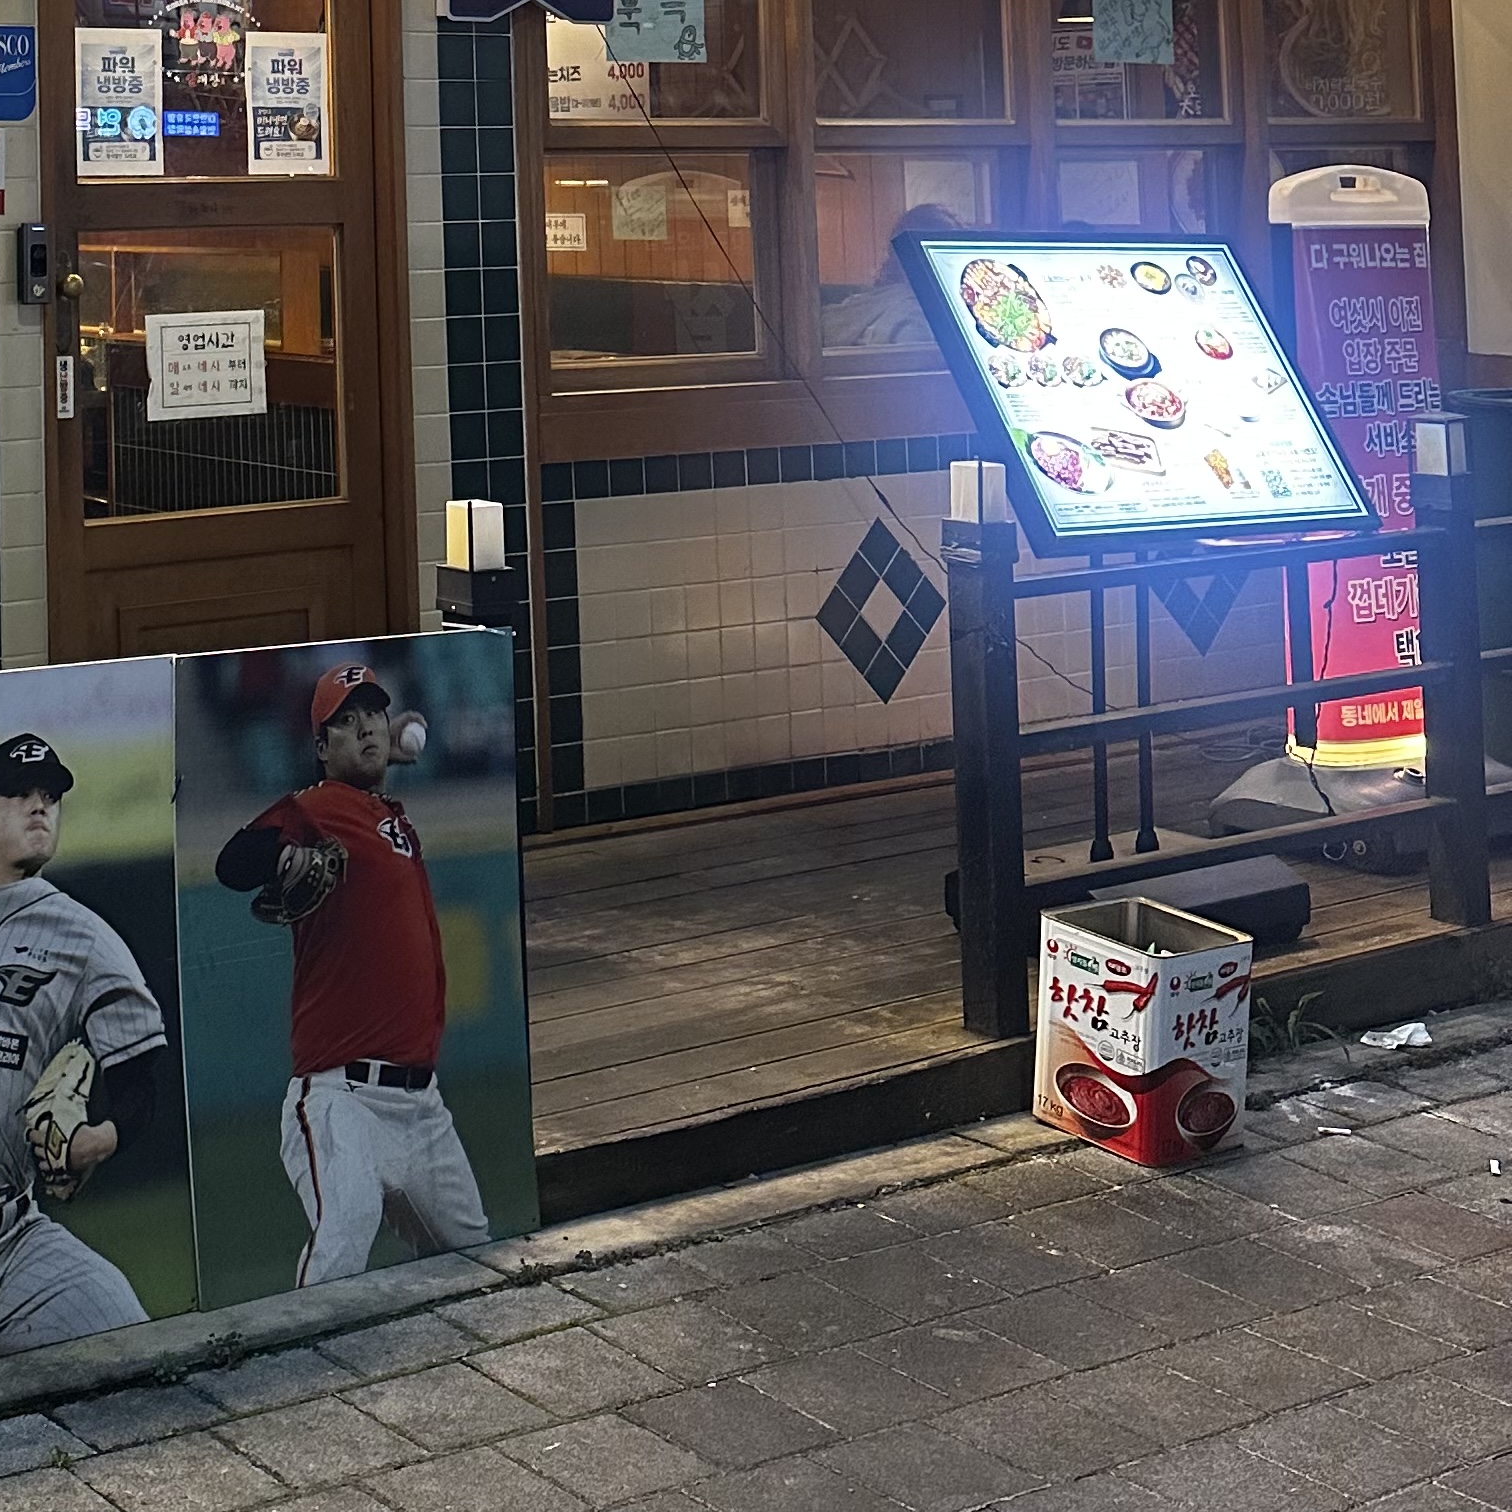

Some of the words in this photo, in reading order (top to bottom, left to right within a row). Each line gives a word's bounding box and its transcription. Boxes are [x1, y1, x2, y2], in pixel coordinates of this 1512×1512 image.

[270, 58, 303, 76] 파워
[607, 62, 644, 81] 4,000
[96, 75, 144, 94] 냉방중
[265, 76, 310, 95] 냉방중
[1310, 244, 1329, 269] 다
[1332, 243, 1411, 270] 구워나오는
[1413, 242, 1428, 269] 집
[1329, 295, 1387, 334] 여섯시
[1388, 295, 1424, 332] 이전
[178, 331, 235, 351] 영업시간
[1343, 337, 1381, 376] 입장
[1384, 337, 1419, 374] 주문
[1316, 379, 1395, 419] 손님들께
[1396, 377, 1442, 413] 드리는
[1347, 573, 1419, 624] 껍데기
[1340, 701, 1399, 728] 동네에서
[1109, 1028, 1142, 1053] 고추장
[1219, 1027, 1244, 1044] 고추장
